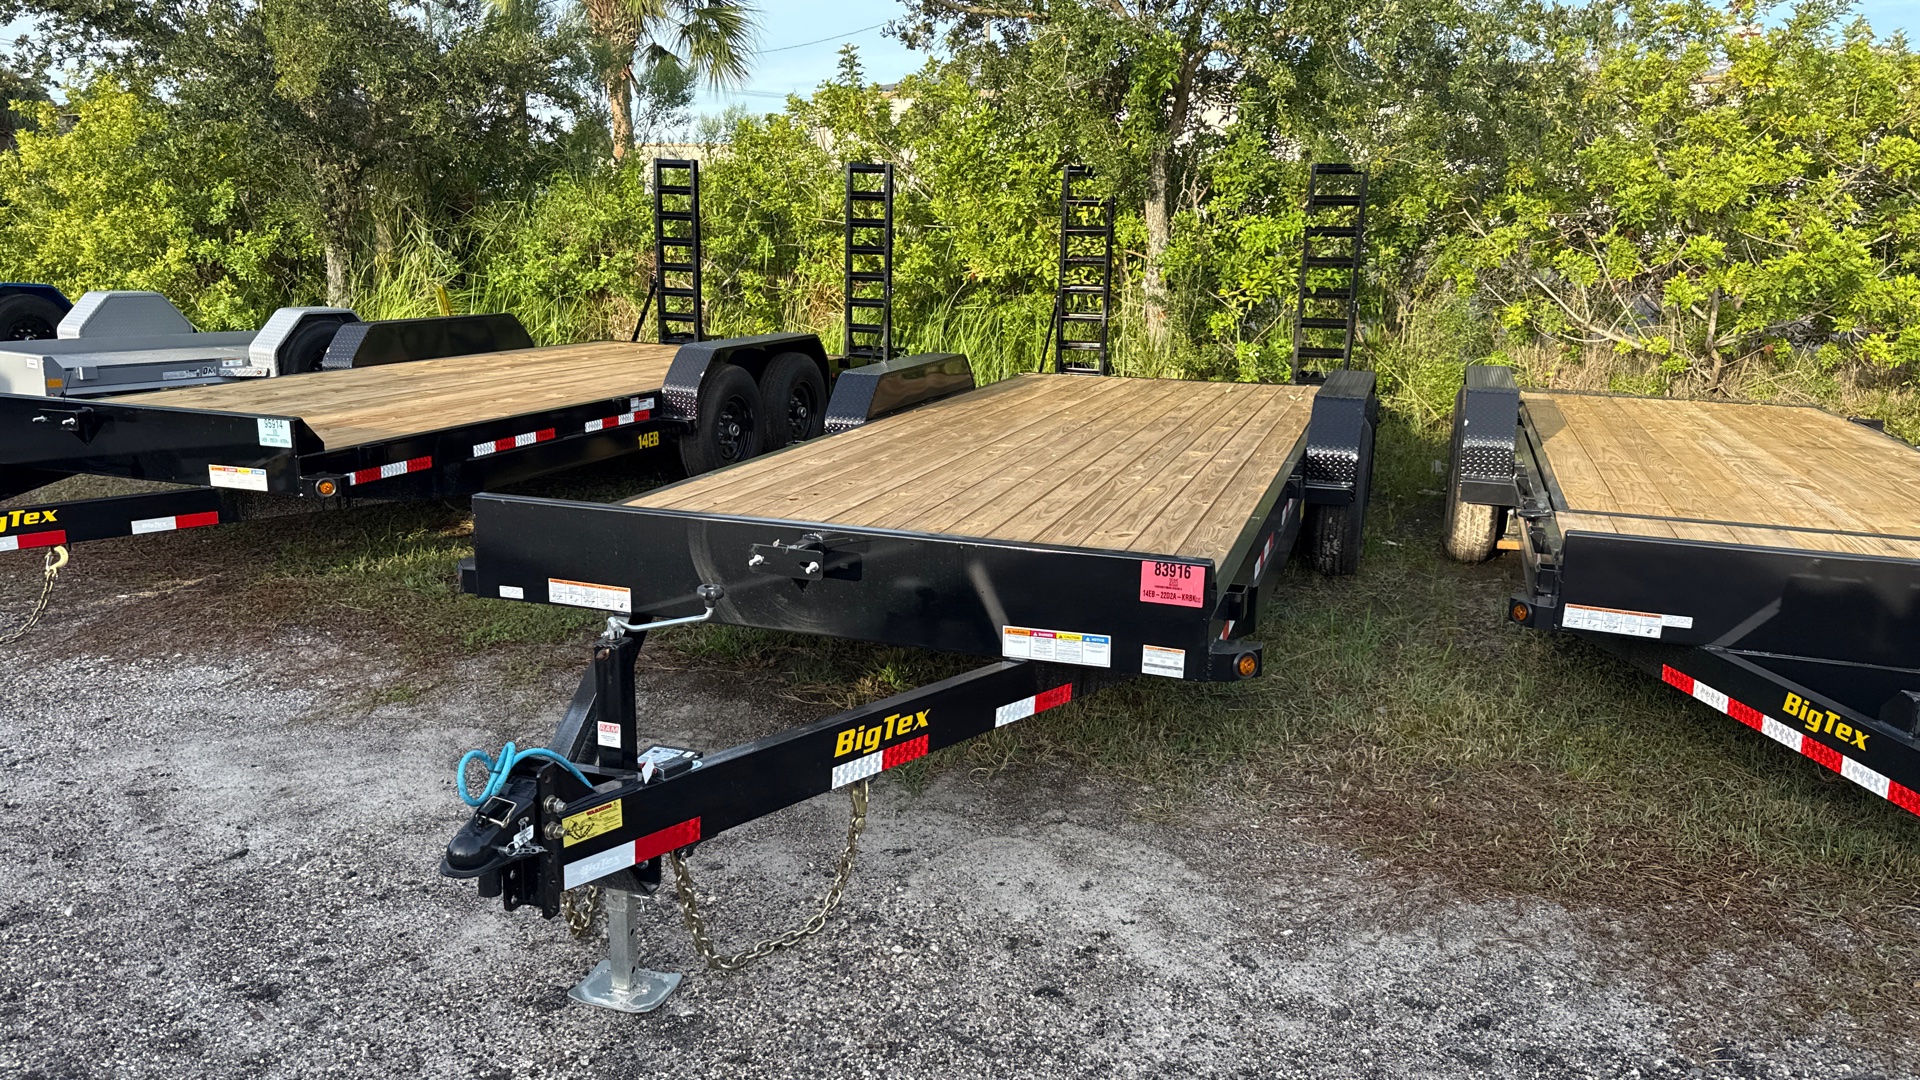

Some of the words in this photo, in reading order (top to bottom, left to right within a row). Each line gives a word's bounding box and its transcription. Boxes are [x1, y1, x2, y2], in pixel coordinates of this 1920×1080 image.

[638, 431, 659, 449] 14EB
[1154, 562, 1191, 579] 83916
[600, 724, 619, 733] RAM
[1782, 691, 1870, 751] BigTex
[834, 709, 930, 757] BigTex
